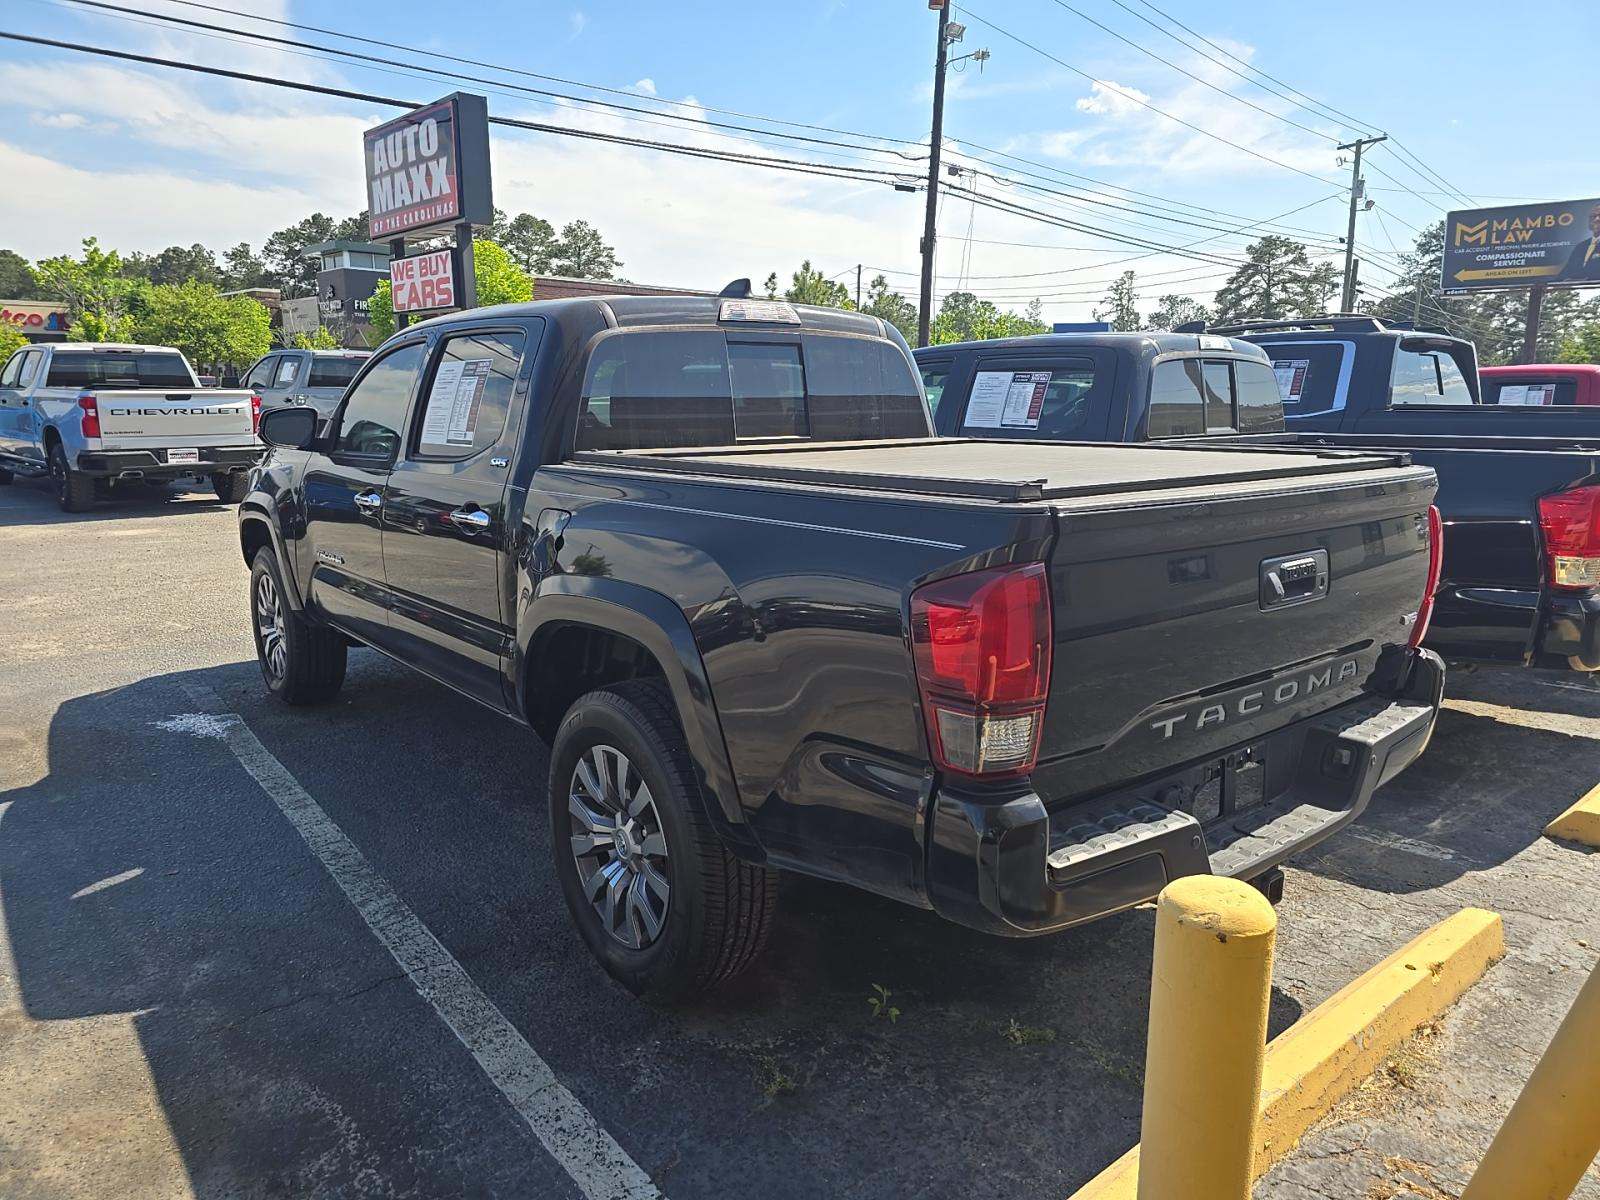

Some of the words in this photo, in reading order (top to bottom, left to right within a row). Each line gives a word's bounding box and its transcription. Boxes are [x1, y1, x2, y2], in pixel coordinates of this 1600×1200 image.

[374, 118, 439, 175] AUTO
[371, 156, 451, 215] MAXX
[374, 221, 384, 234] OF
[386, 218, 401, 230] THE
[403, 201, 454, 227] CAROLINAS
[1492, 212, 1574, 232] MAMBO
[1491, 229, 1534, 245] LAW
[392, 261, 414, 282] WE
[419, 252, 449, 278] BUY
[1475, 250, 1546, 262] COMPASSIONATE
[1493, 259, 1526, 267] SERVICE
[393, 276, 452, 311] CARS
[110, 407, 242, 416] CHEVROLET
[1151, 659, 1358, 738] TACOMA
